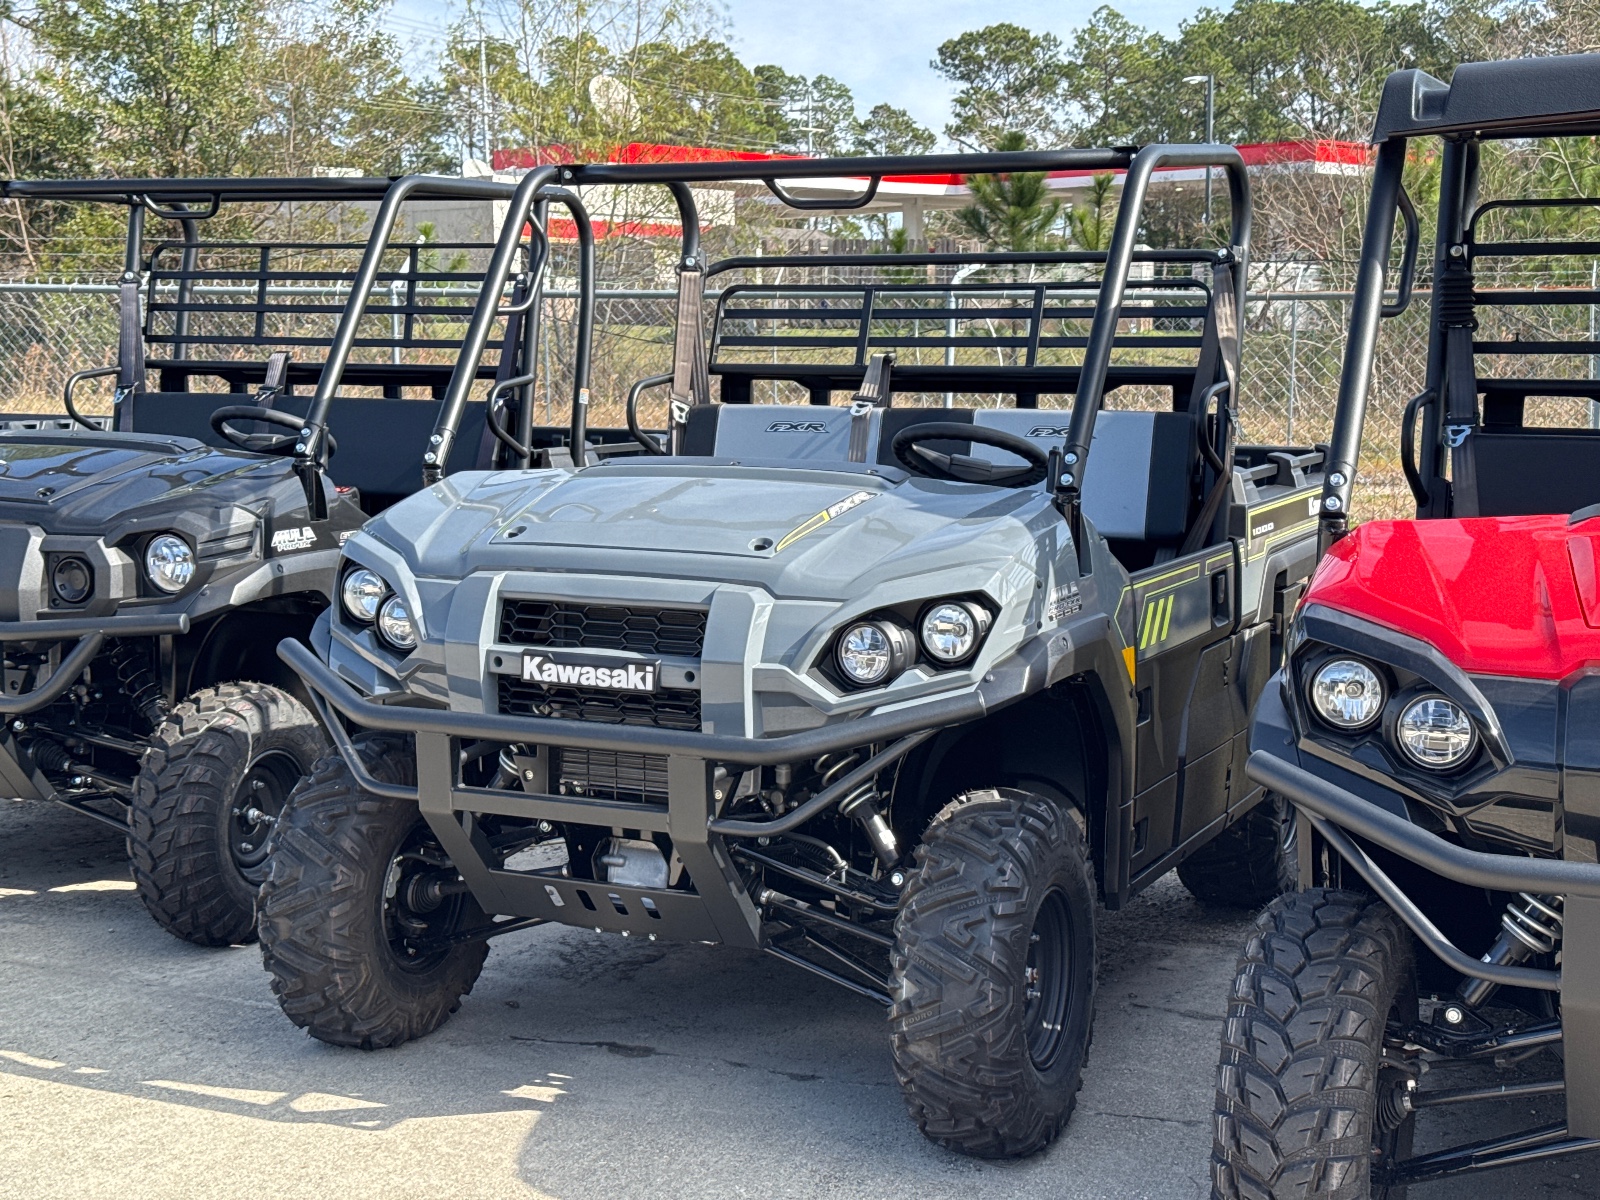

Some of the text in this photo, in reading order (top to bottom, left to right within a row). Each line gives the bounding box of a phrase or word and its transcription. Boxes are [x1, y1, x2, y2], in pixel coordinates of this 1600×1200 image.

[765, 420, 829, 434] FXR
[1025, 425, 1070, 438] FX
[828, 491, 877, 519] FXR
[1252, 522, 1274, 536] 1000
[523, 655, 653, 690] Kawasaki
